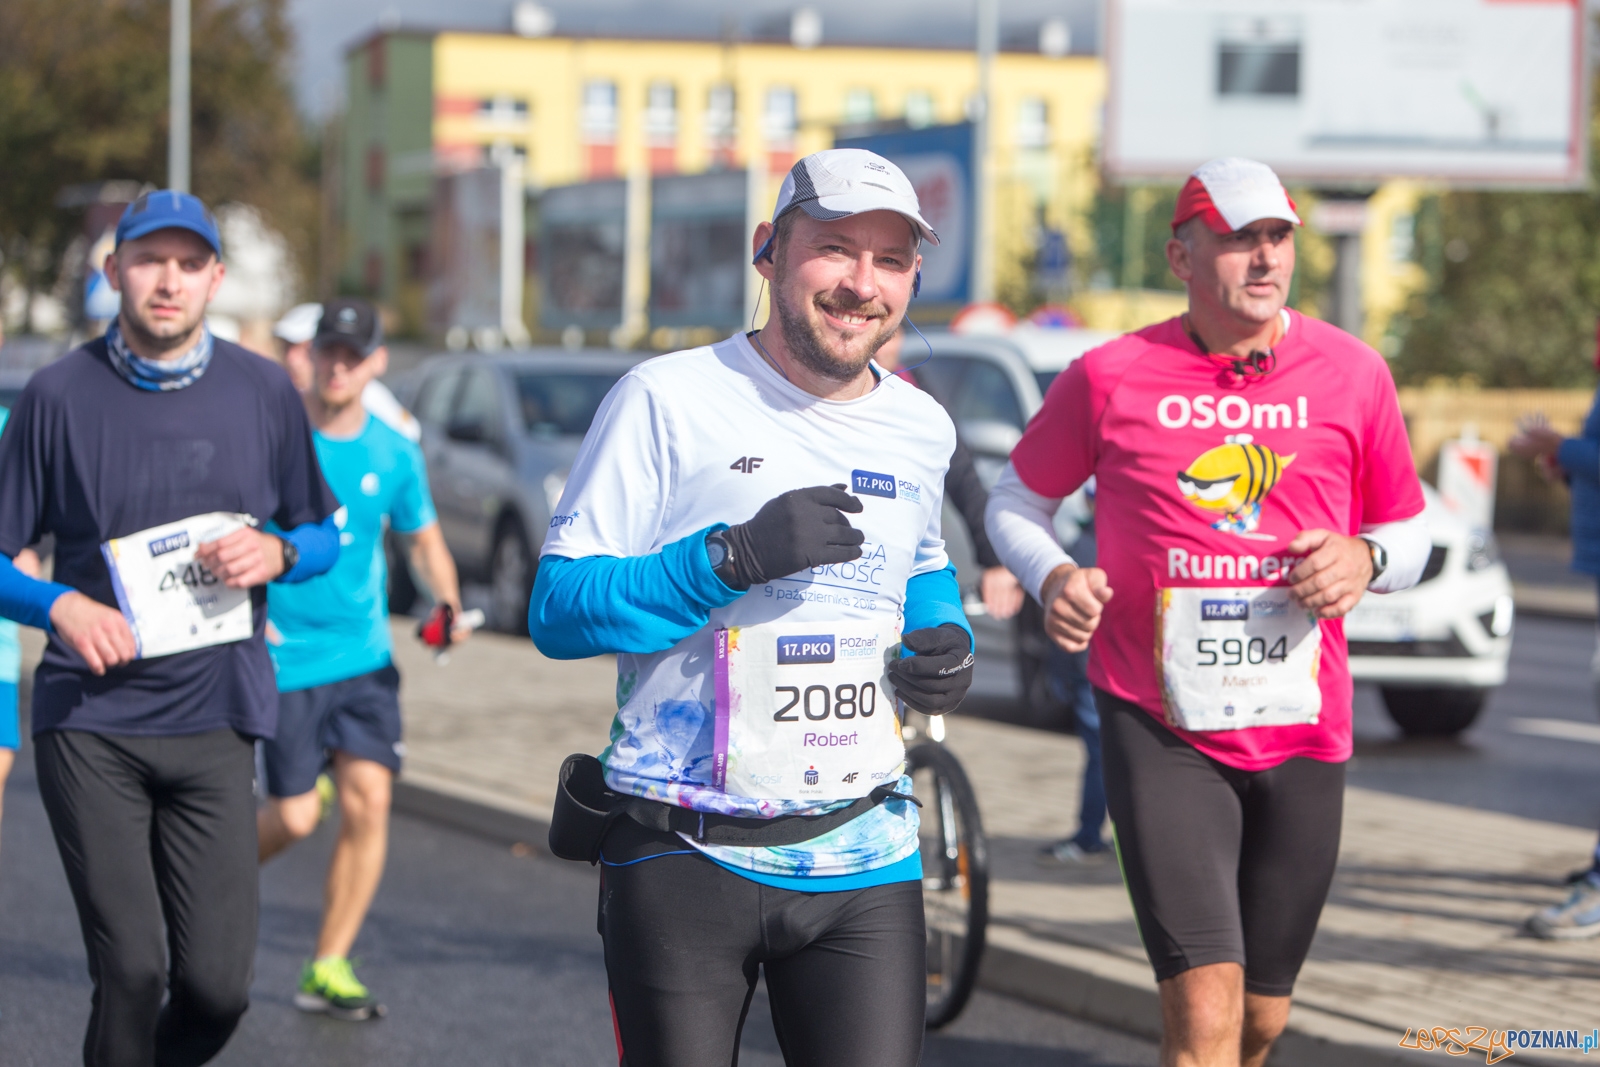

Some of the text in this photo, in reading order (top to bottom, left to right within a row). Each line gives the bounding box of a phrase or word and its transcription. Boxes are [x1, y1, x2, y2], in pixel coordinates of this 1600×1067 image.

[730, 456, 764, 474] 4F
[764, 585, 877, 611] 9 października 2016
[1197, 635, 1288, 667] 5904
[773, 681, 876, 722] 2080
[803, 730, 858, 747] Robert
